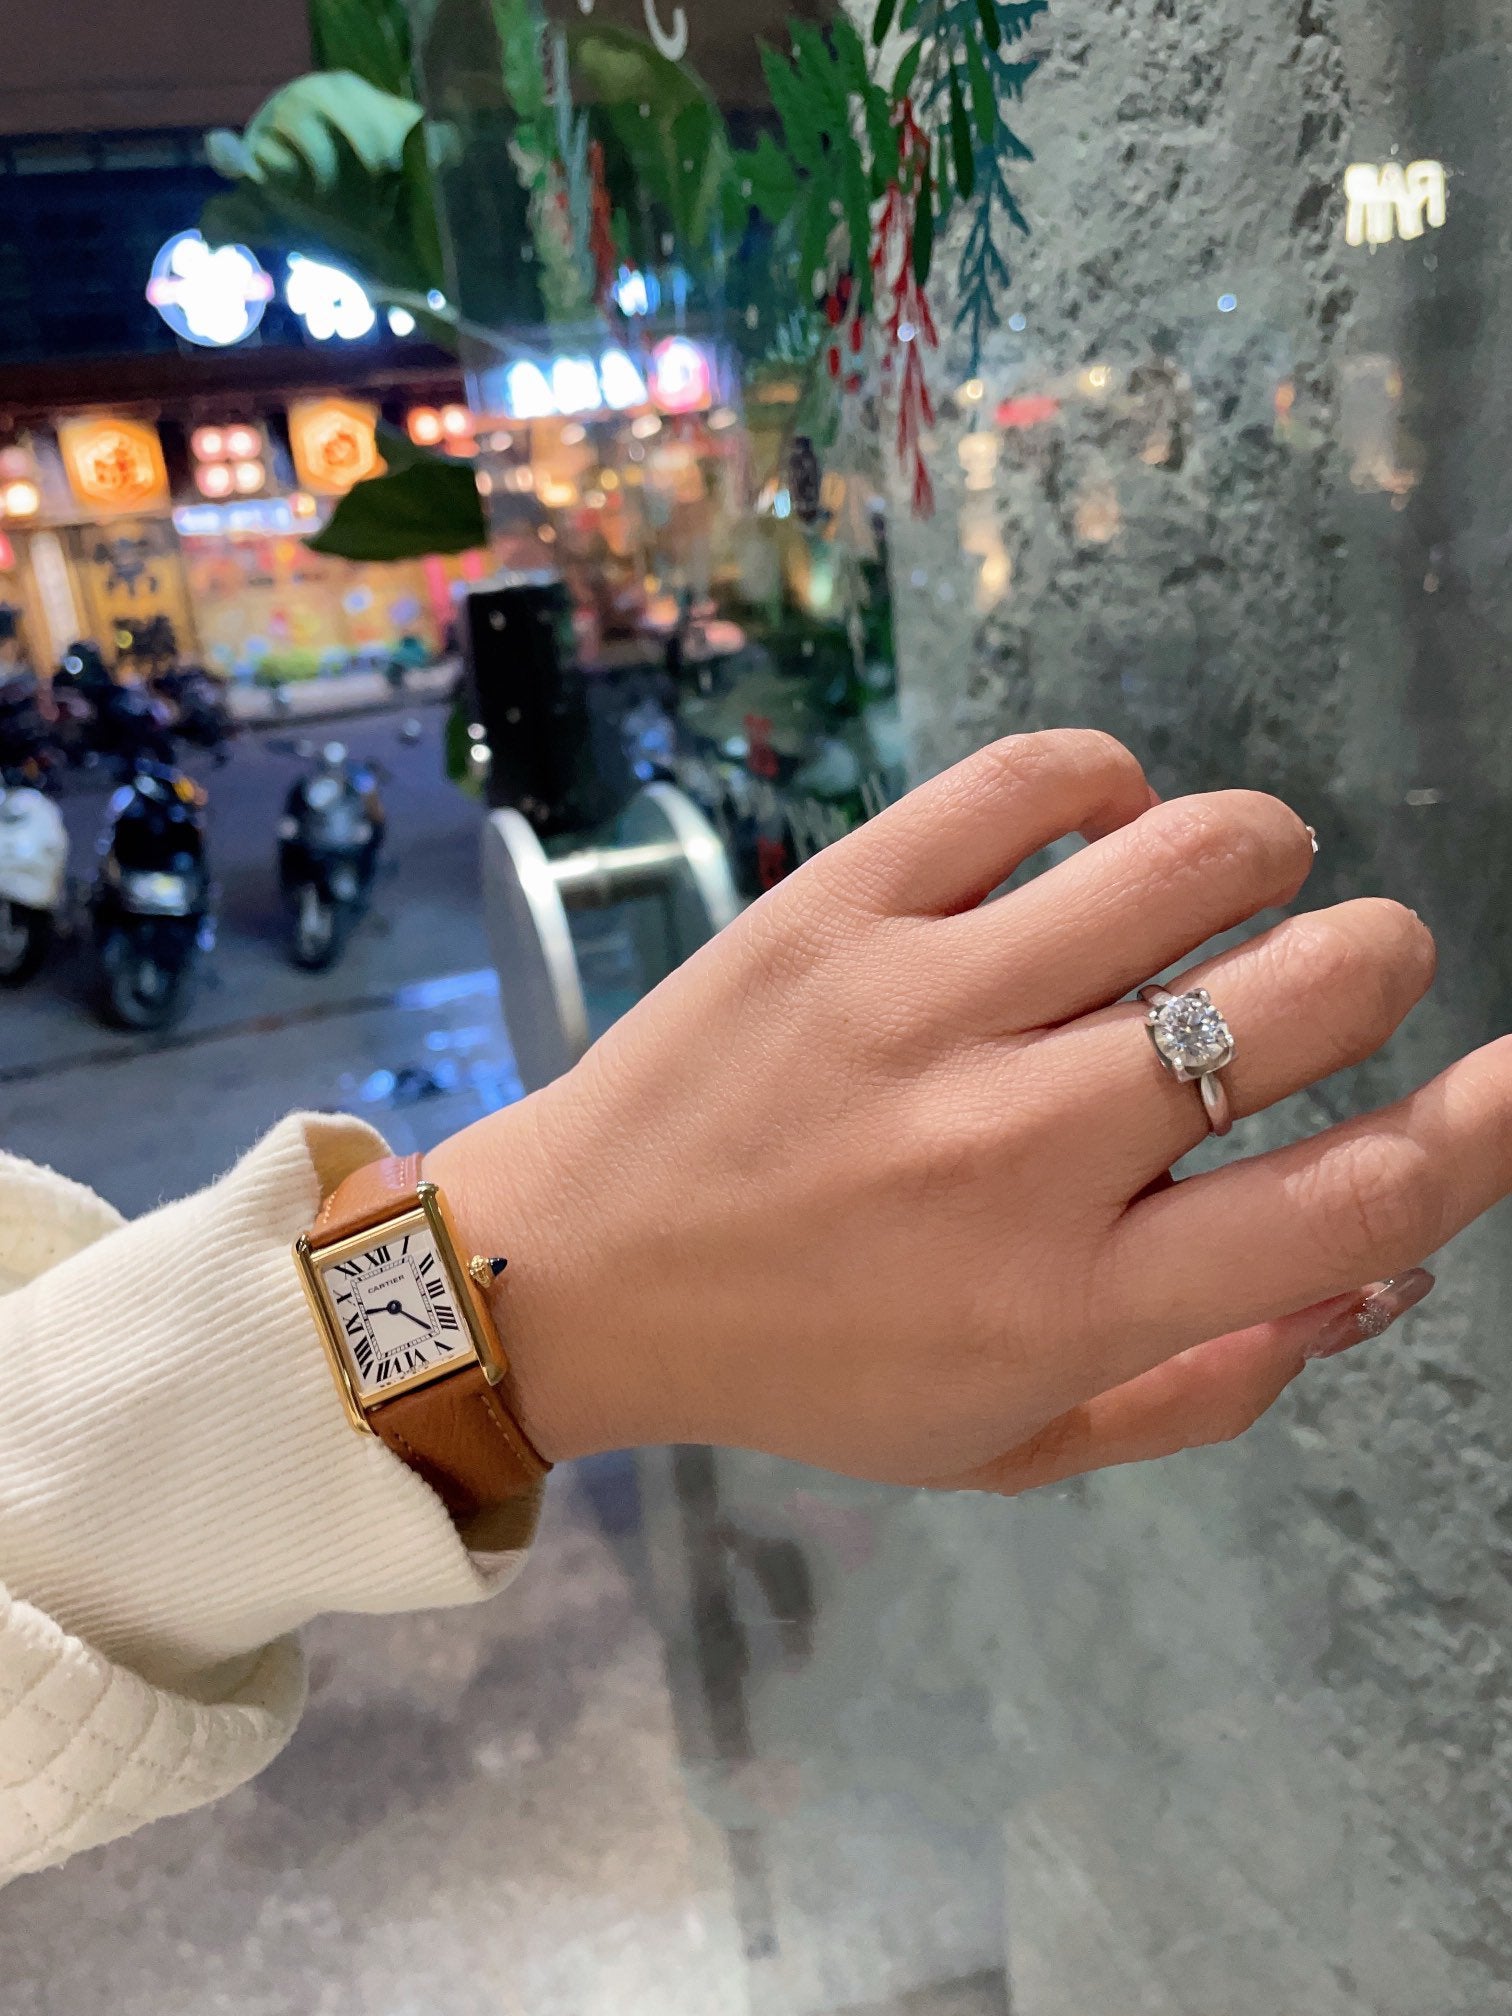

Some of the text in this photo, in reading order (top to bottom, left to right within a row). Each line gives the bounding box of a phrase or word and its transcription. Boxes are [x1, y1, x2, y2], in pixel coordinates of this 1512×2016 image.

[364, 1245, 391, 1270] XII
[418, 1252, 434, 1277] II
[333, 1260, 363, 1280] XI
[368, 1274, 405, 1294] CARTIER
[426, 1278, 446, 1299] III
[333, 1290, 356, 1307] X
[343, 1312, 364, 1336] IX
[353, 1335, 375, 1380] VIII
[404, 1348, 428, 1370] VI
[434, 1340, 454, 1356] V
[376, 1357, 402, 1384] VII
